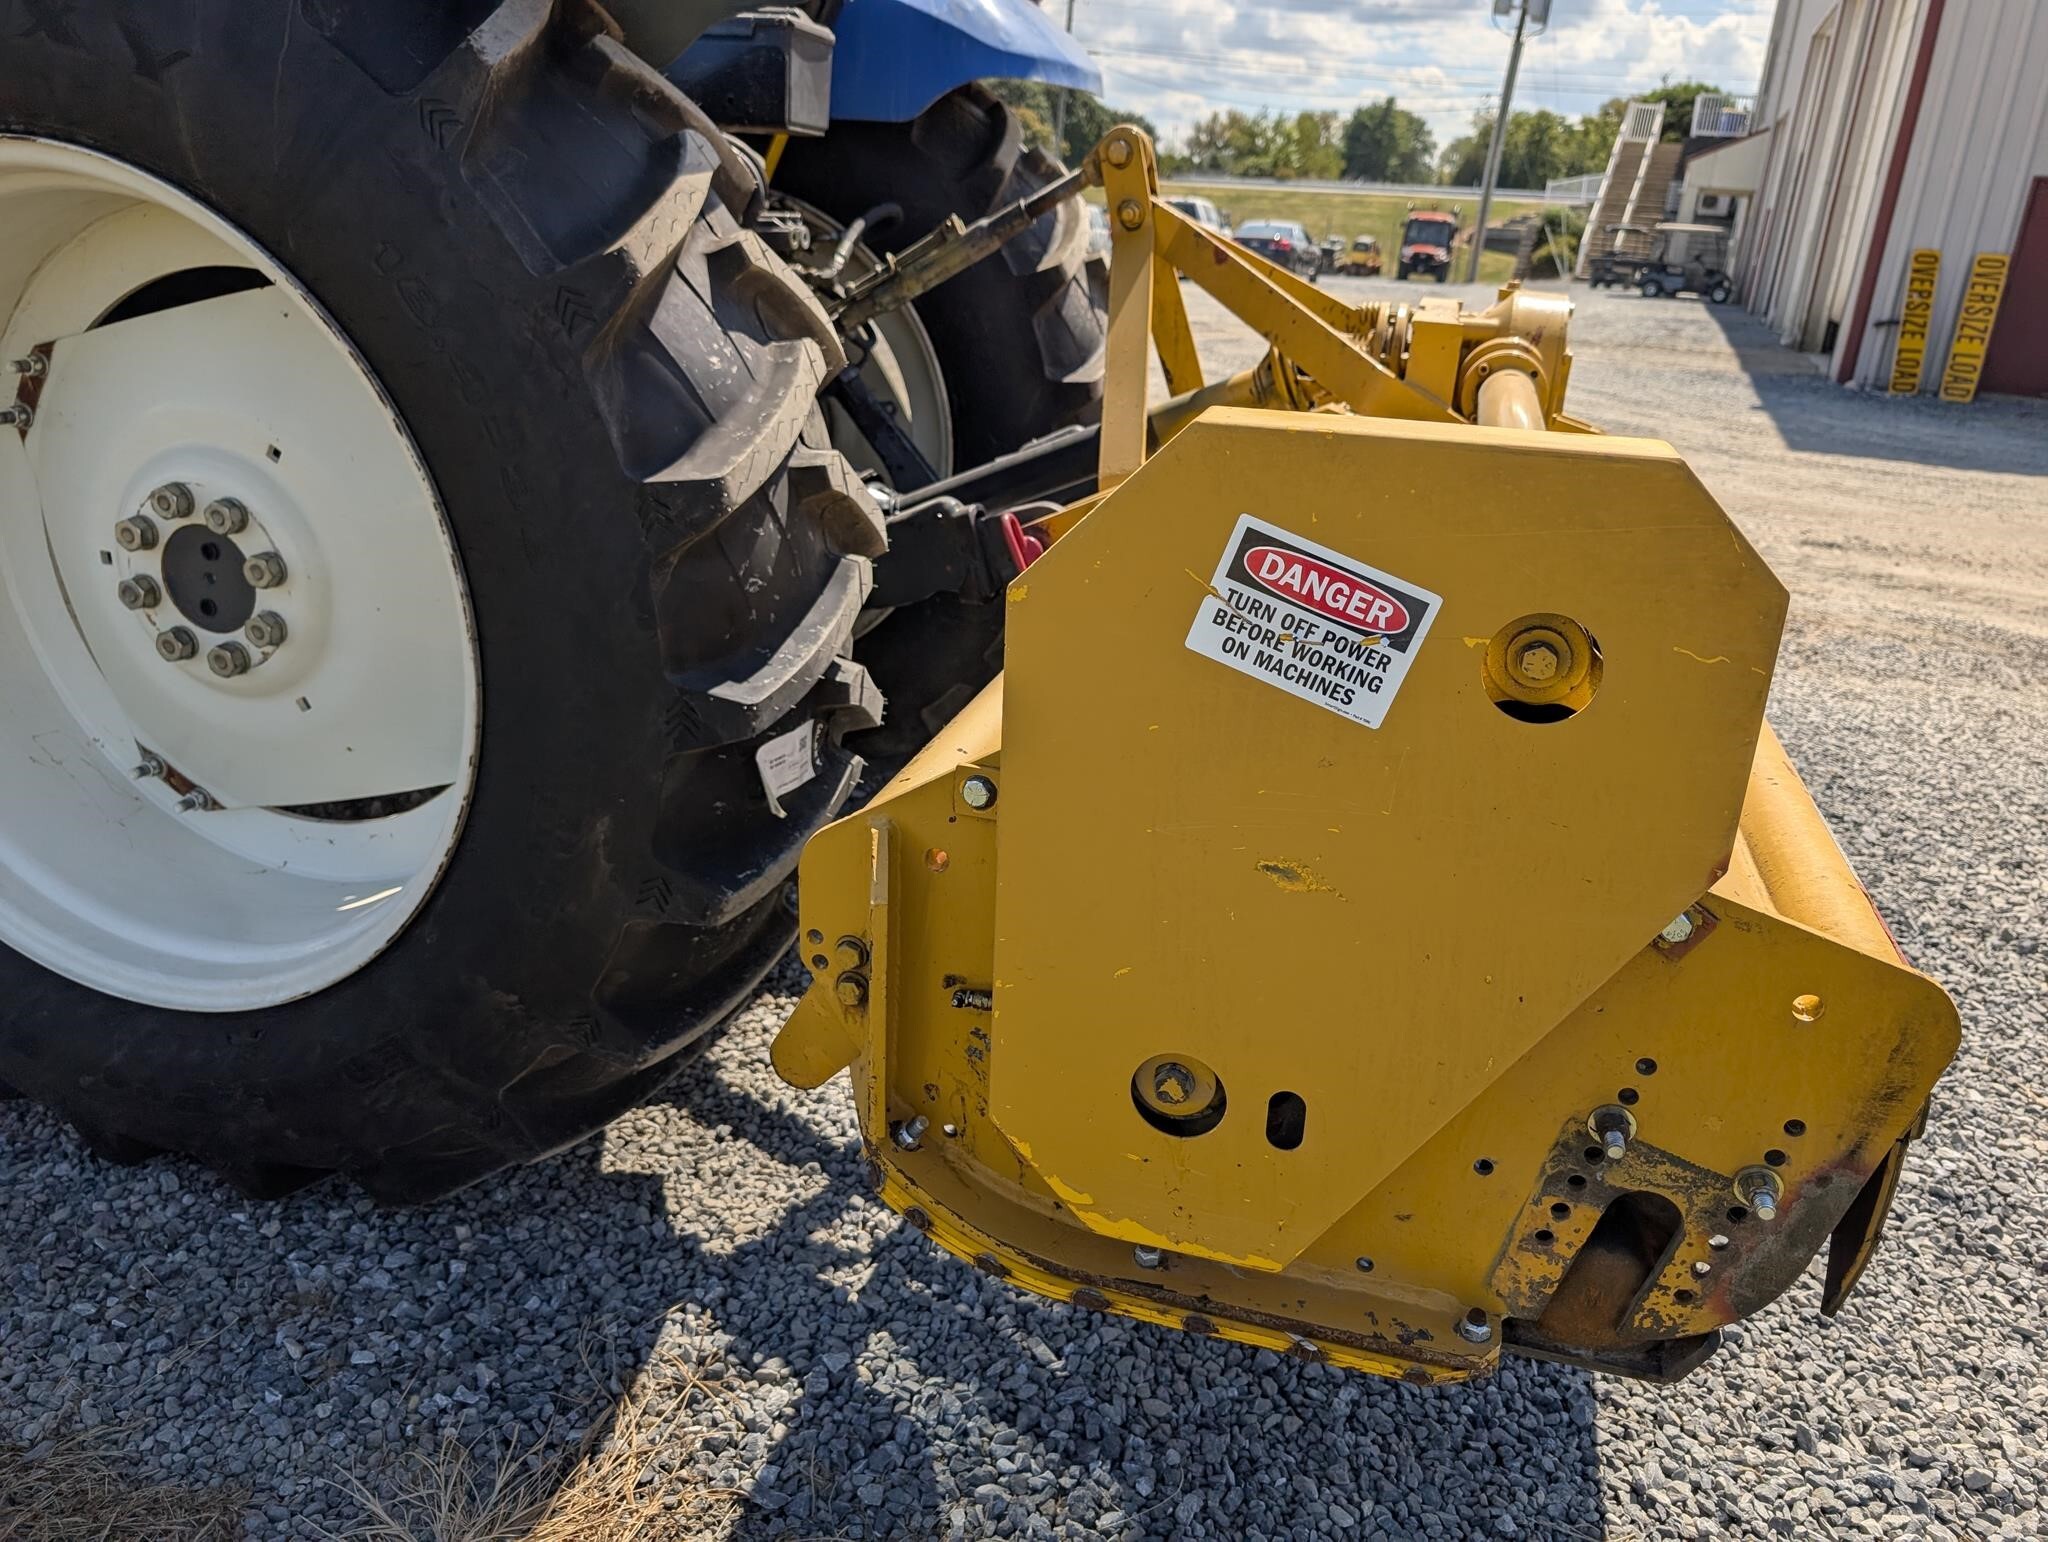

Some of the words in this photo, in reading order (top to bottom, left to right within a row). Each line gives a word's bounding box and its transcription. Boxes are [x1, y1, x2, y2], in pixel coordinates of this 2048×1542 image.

[1901, 253, 1939, 340] OVERSIZE
[1957, 258, 2006, 345] OVERSIZE
[1891, 348, 1922, 392] LOAD
[1943, 353, 1981, 398] LOAD
[1227, 587, 1278, 624] TURN
[1280, 613, 1320, 640] OFF
[1321, 629, 1392, 674] POWER
[1258, 552, 1394, 630] DANGER
[1212, 608, 1287, 654] BEFORE
[1291, 636, 1384, 695] WORKING
[1221, 636, 1251, 661] ON
[1253, 649, 1356, 706] MACHINES
